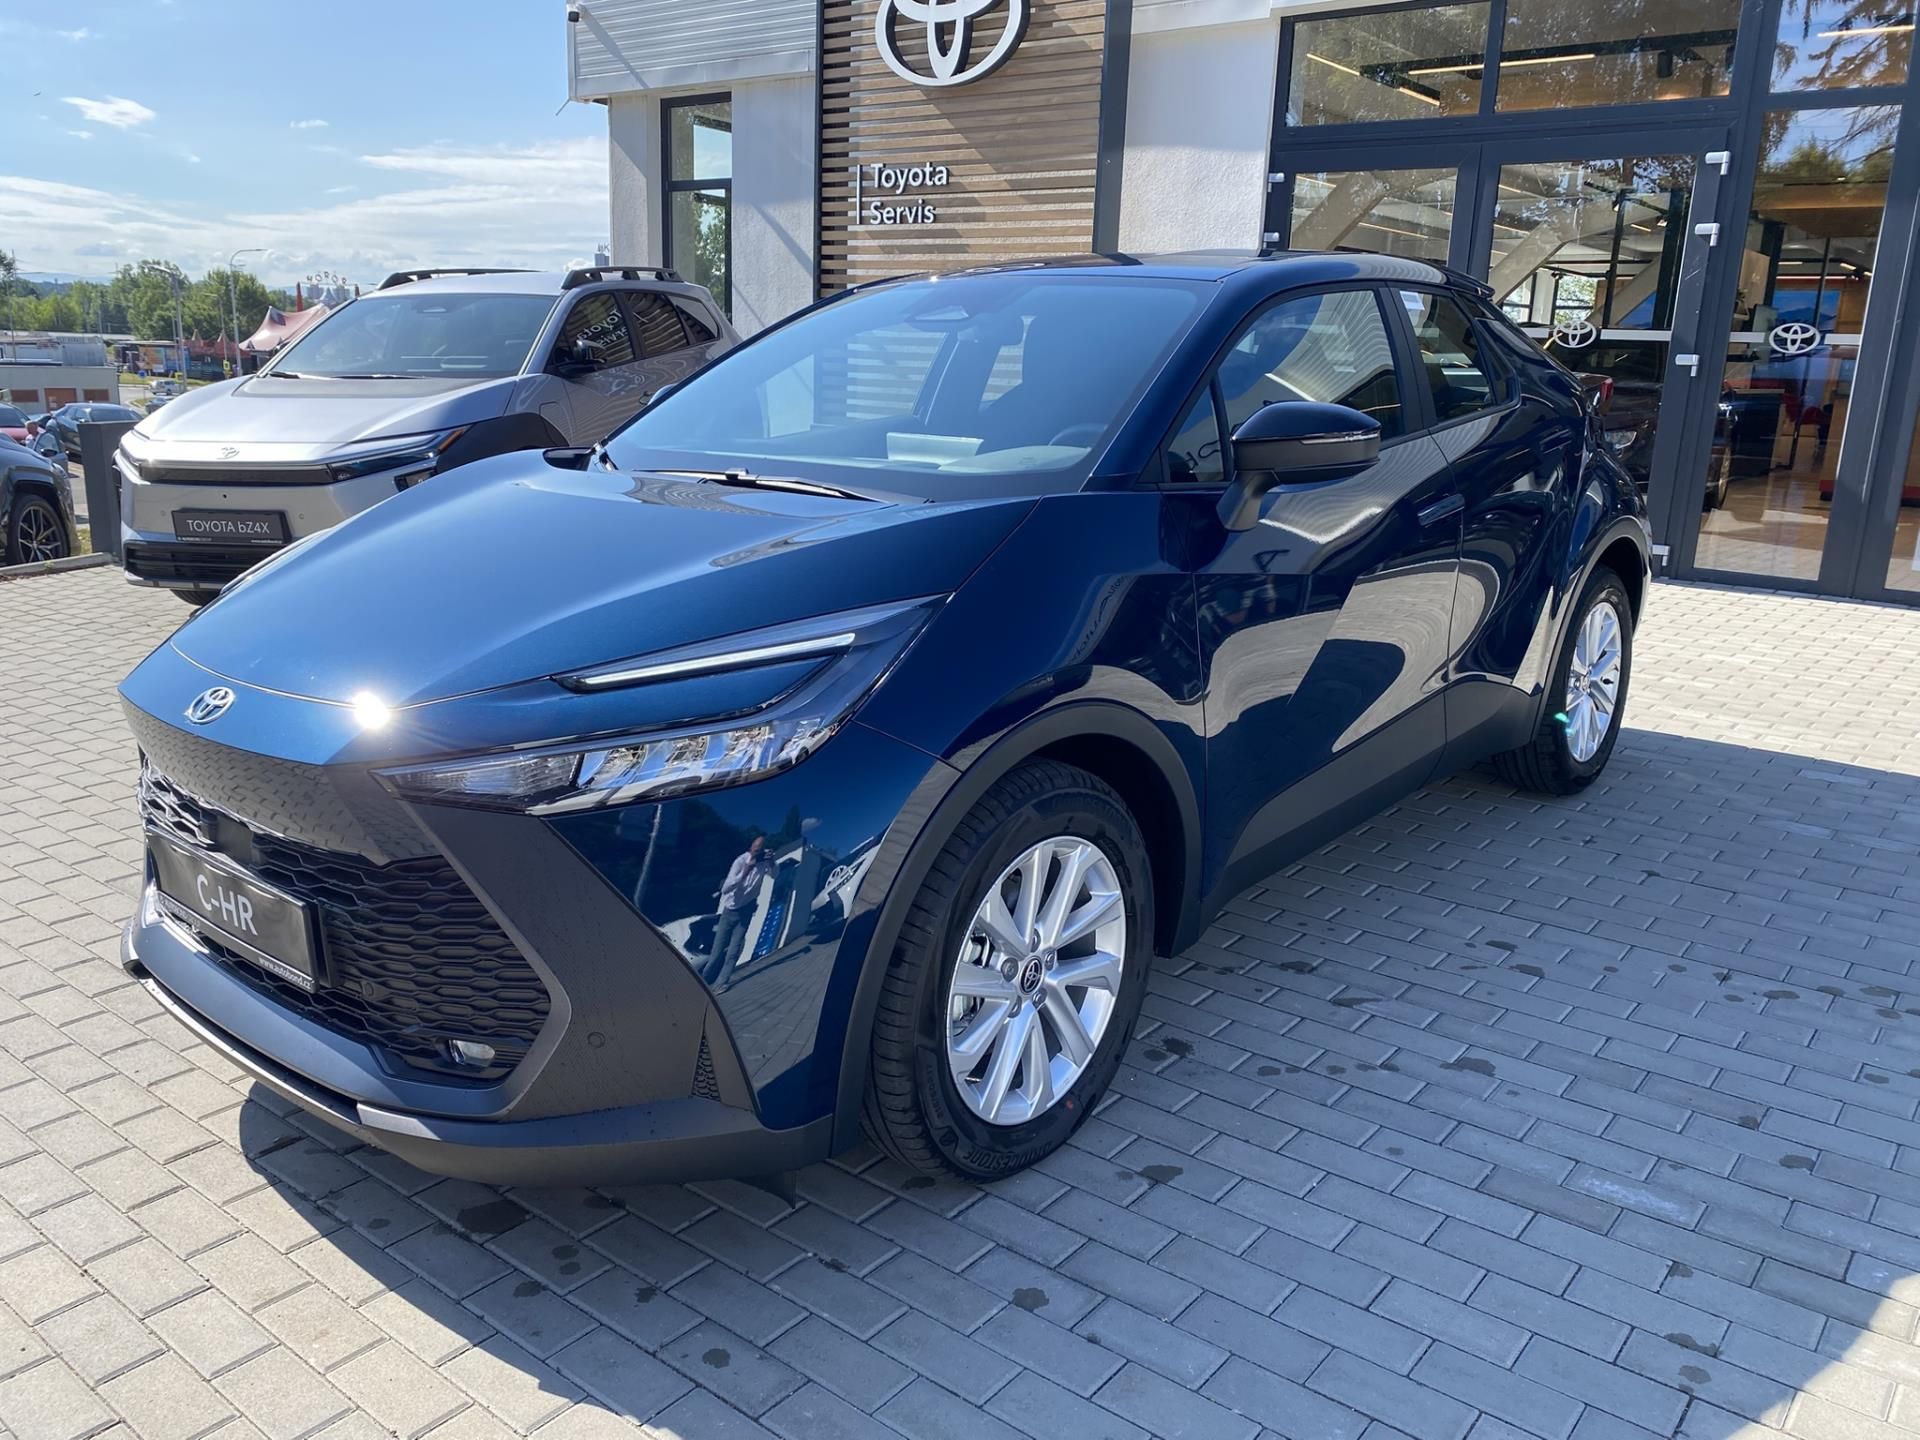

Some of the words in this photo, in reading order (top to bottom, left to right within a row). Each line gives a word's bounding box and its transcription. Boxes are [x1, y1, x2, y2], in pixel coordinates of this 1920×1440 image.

[870, 162, 947, 194] Toyota
[870, 199, 935, 224] Servis
[186, 520, 236, 533] TOYOTA
[238, 521, 270, 534] bZ4X
[197, 874, 258, 936] C-HR
